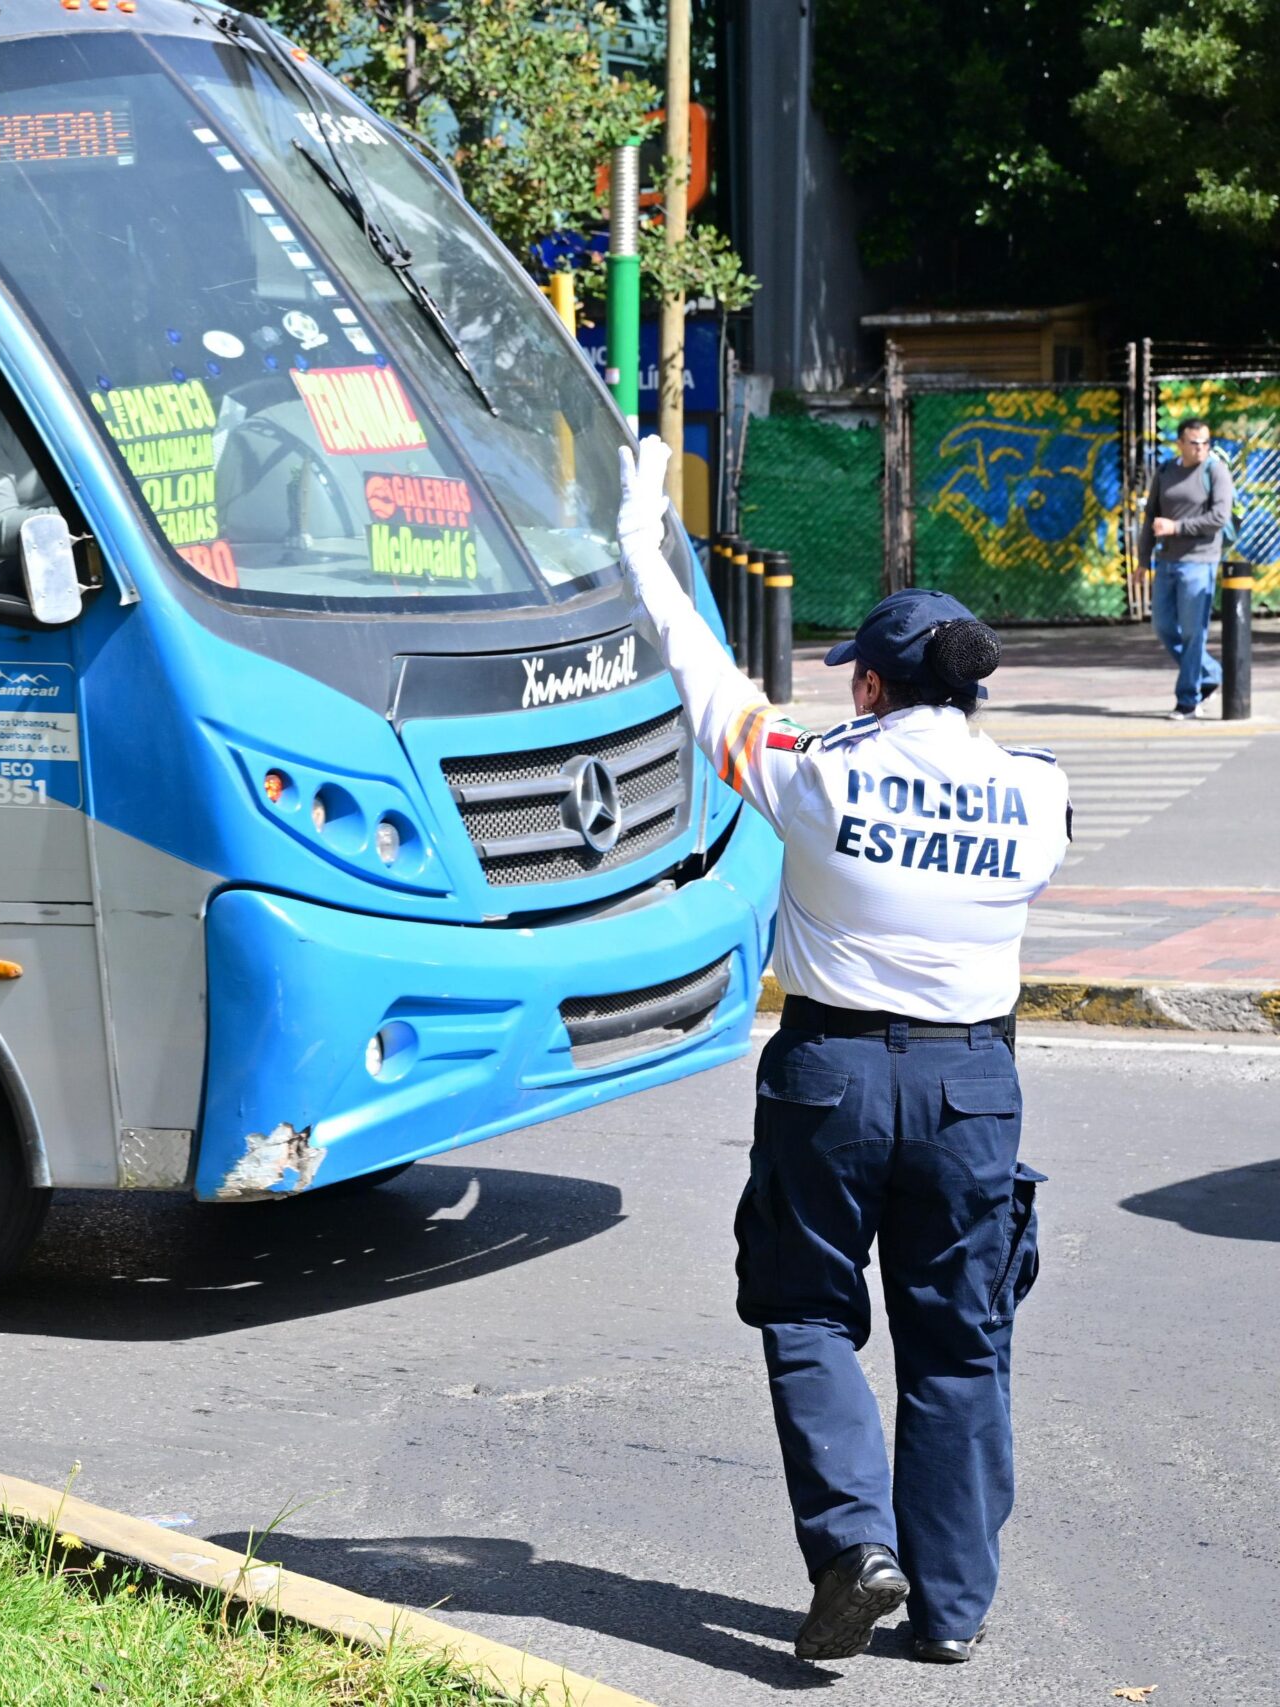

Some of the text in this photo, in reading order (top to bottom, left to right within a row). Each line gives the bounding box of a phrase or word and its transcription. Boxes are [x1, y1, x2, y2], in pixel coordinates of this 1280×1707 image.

[121, 380, 217, 438] PACIFICO
[12, 718, 49, 729] Urbanos
[38, 744, 50, 754] de
[0, 761, 34, 777] ECO
[846, 768, 1029, 826] POLICÍA
[834, 814, 1021, 880] ESTATAL
